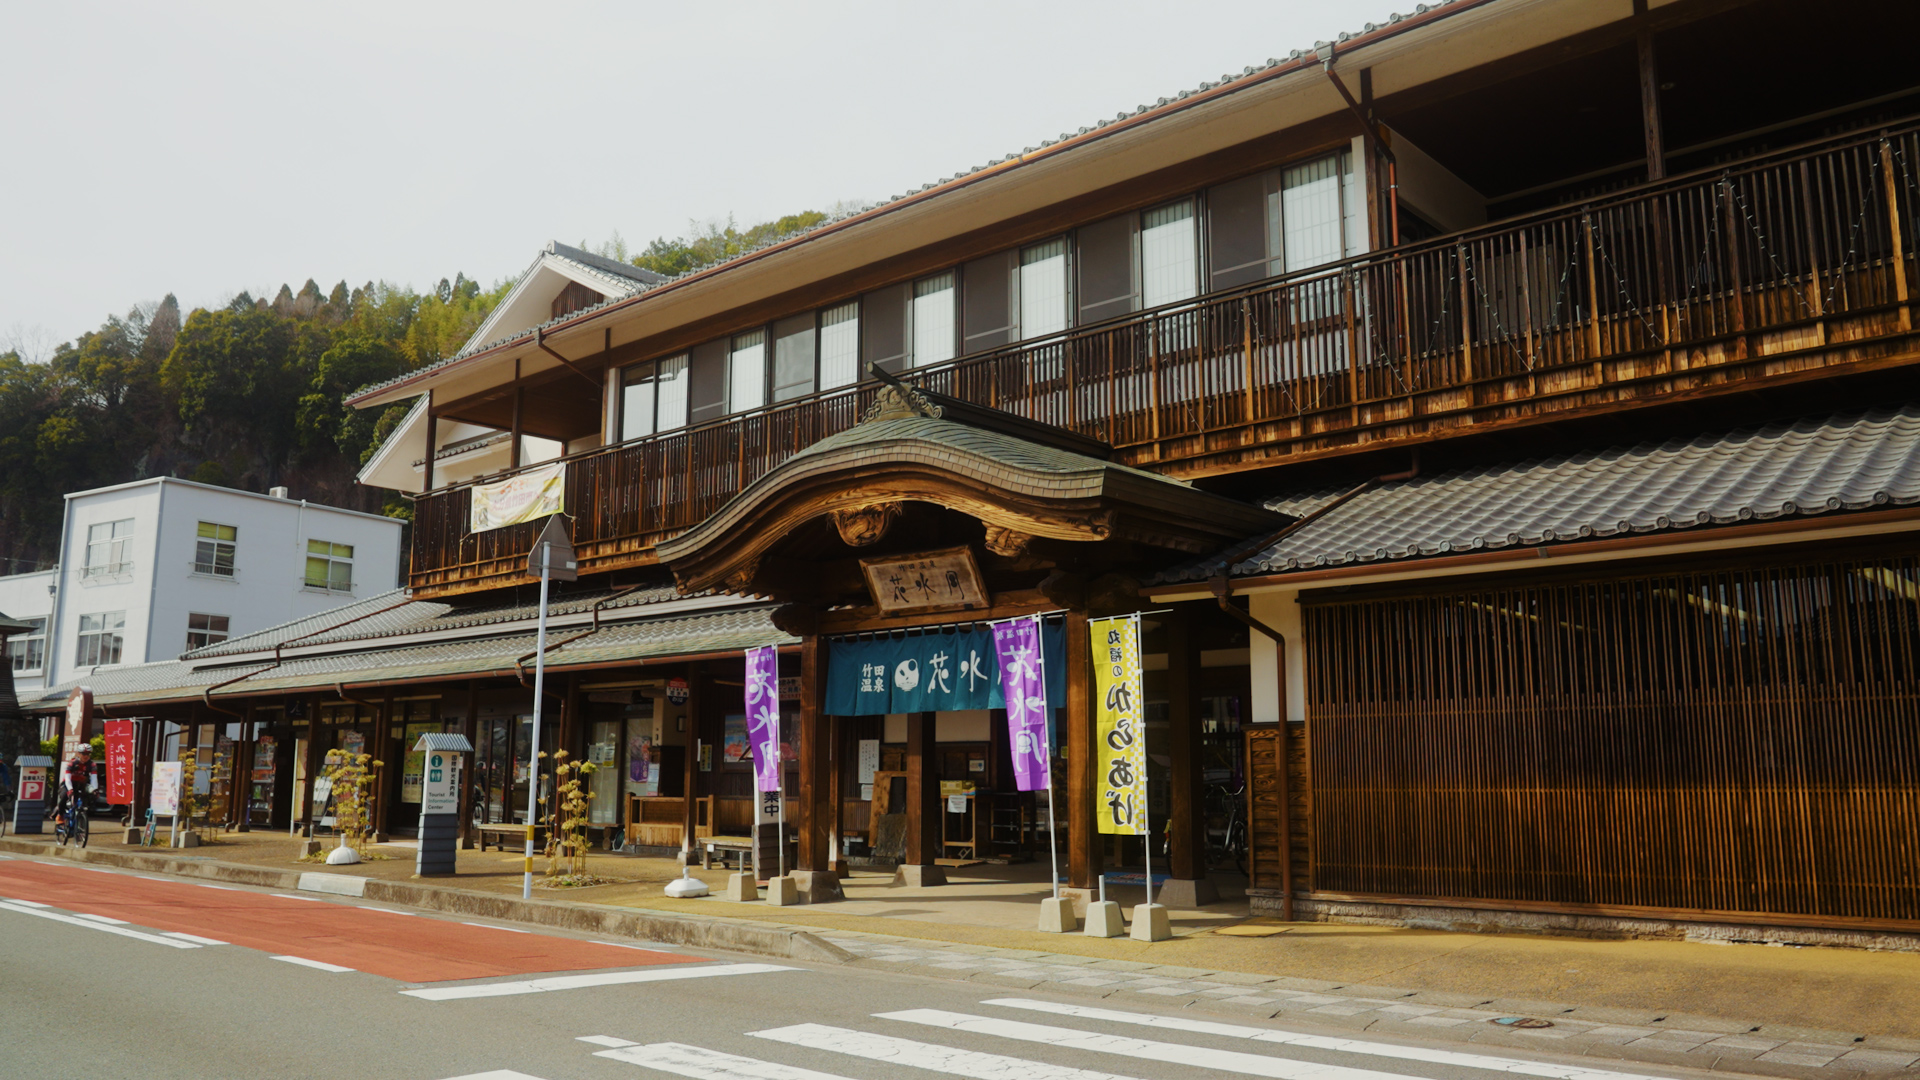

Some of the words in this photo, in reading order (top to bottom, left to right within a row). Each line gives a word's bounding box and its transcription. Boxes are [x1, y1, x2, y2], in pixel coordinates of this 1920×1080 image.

[898, 560, 937, 572] 竹田温泉
[889, 570, 965, 603] 花水月
[861, 663, 886, 678] 竹田
[927, 650, 1001, 694] 花水
[860, 677, 886, 692] 温泉
[25, 783, 40, 798] P
